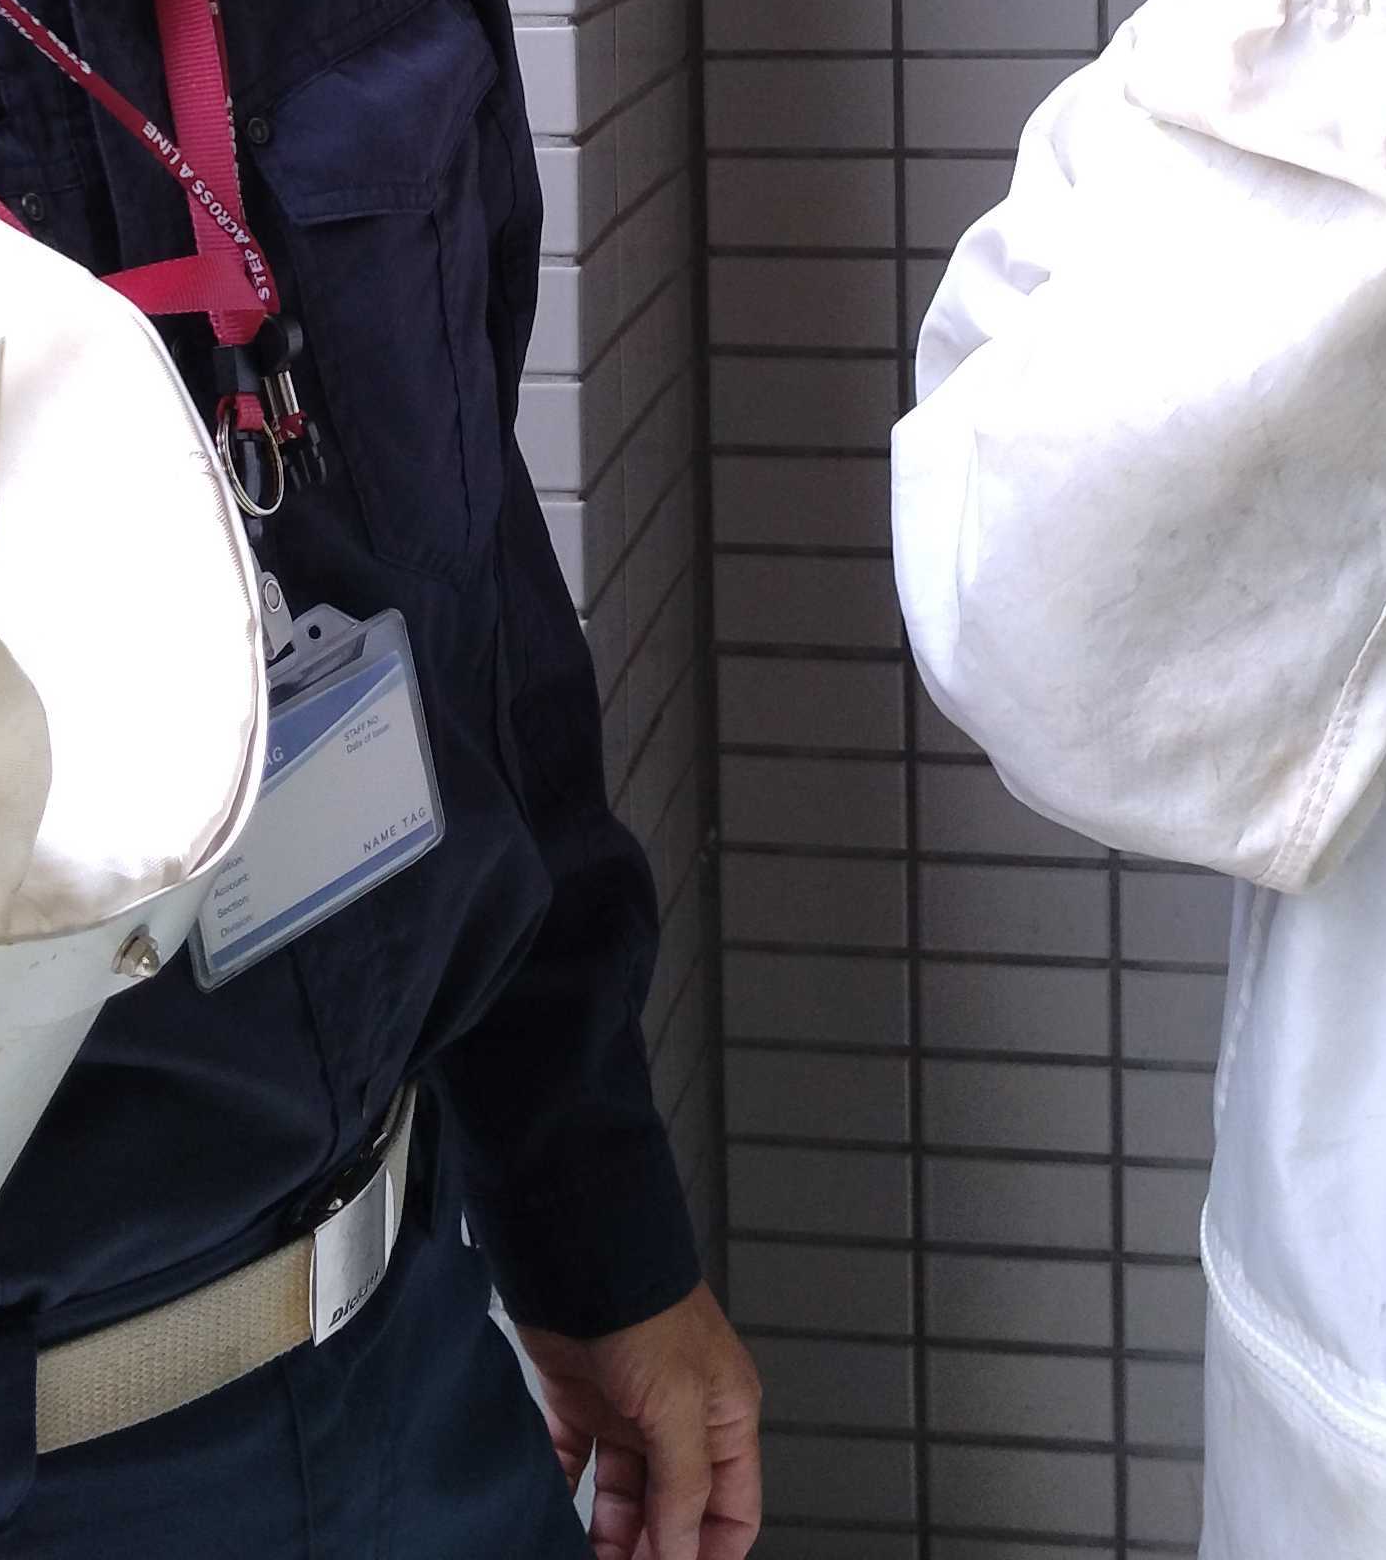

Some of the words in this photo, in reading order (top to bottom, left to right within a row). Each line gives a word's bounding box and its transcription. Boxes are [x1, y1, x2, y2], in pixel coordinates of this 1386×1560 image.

[141, 120, 183, 166] LINE
[178, 161, 195, 179] A
[191, 179, 252, 245] ACROSS
[244, 248, 271, 301] STEP
[264, 746, 285, 767] AG
[363, 823, 398, 853] NAME
[402, 807, 427, 829] TAG
